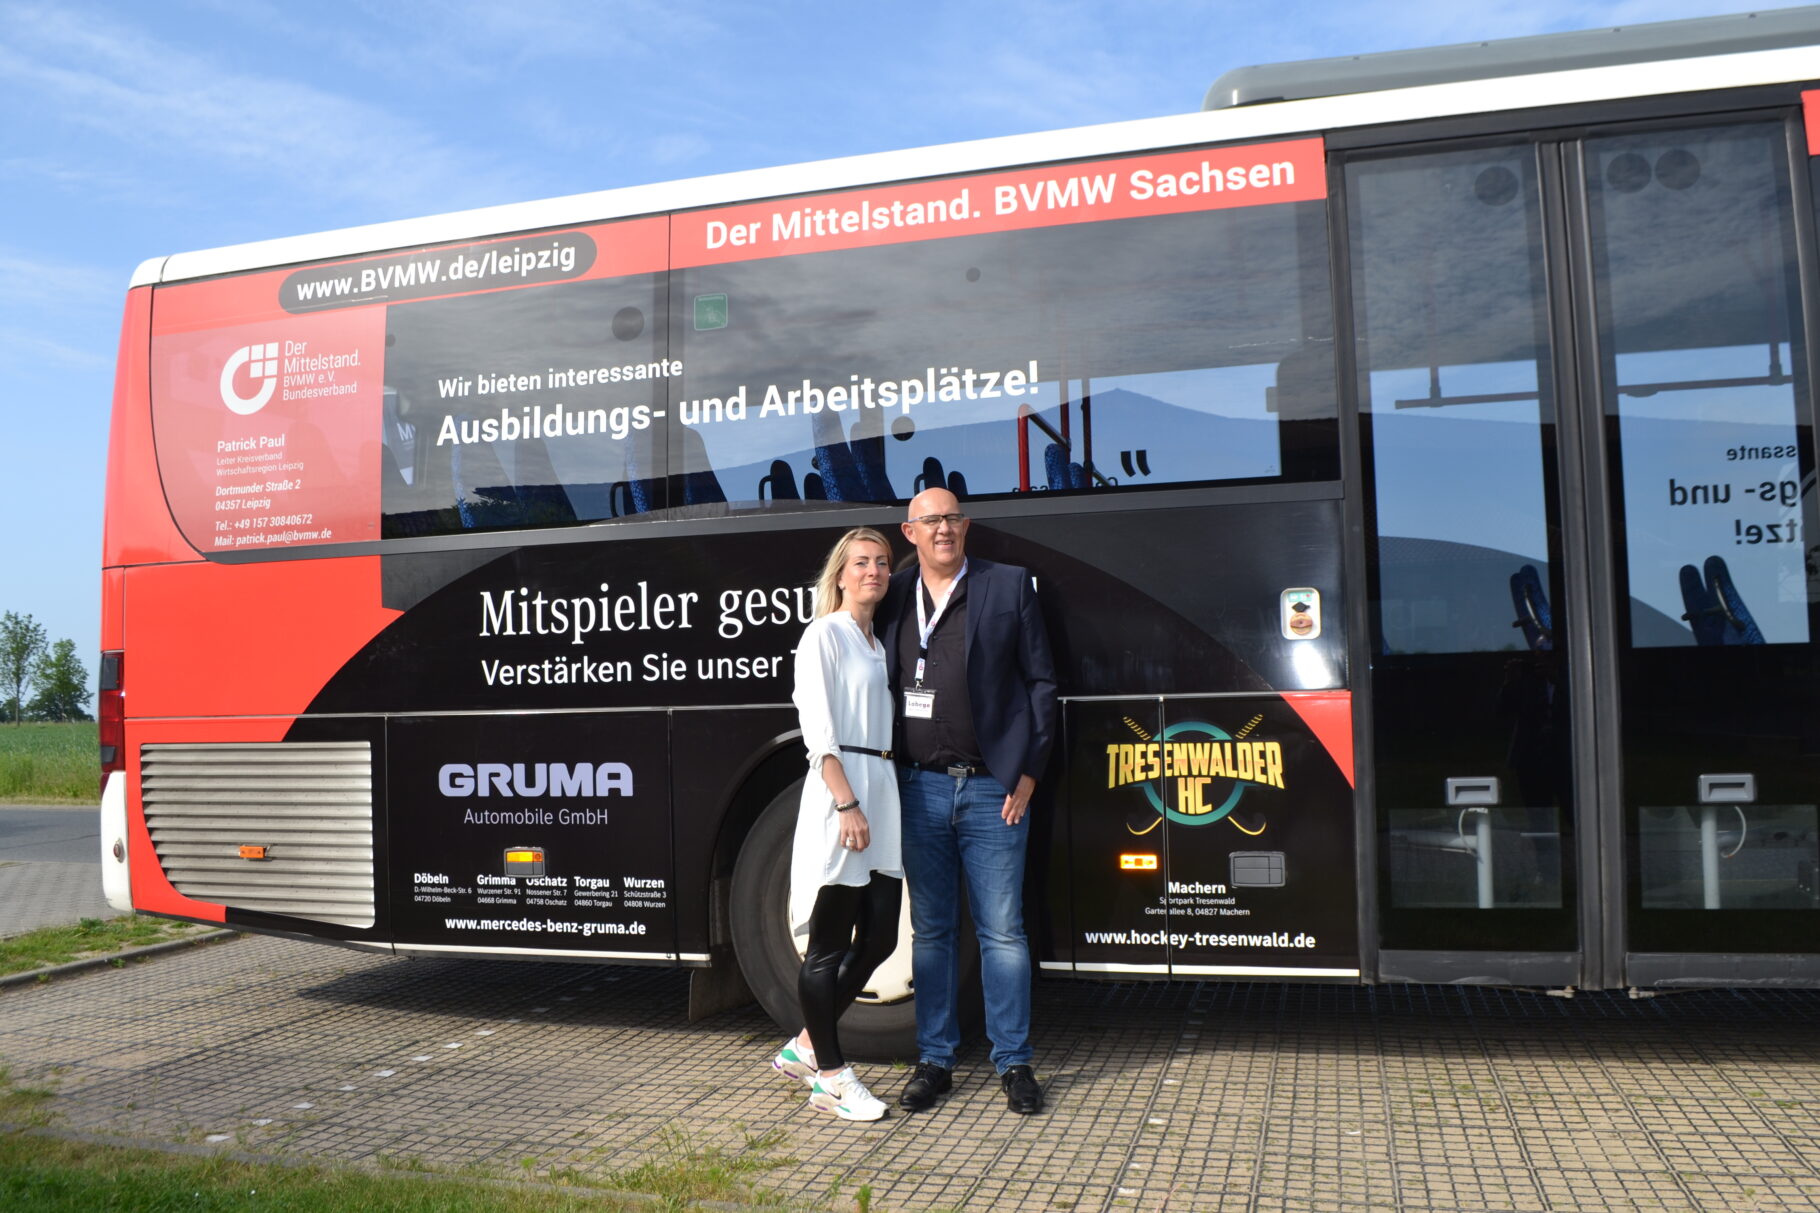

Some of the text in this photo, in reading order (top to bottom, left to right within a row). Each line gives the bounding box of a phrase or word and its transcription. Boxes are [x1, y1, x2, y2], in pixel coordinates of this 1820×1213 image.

[706, 160, 1296, 250] Der Mittelstand. BVMW Sachsen
[296, 242, 577, 301] www.BVMW.de/leipzig
[285, 340, 307, 356] Der
[284, 349, 361, 374] Mittelstand.
[283, 373, 315, 387] BVMW
[438, 358, 683, 398] Wir bieten interessante
[283, 381, 357, 400] Bundesverband
[436, 360, 1040, 447] Ausbildungs- und Arbeitsplätze!
[217, 434, 285, 453] Patrick Paul
[217, 452, 283, 466] Leiter Kreisverband
[216, 461, 304, 476] Wirtschaftsregion Leipzig
[216, 479, 301, 496] Dortmunder Straße 2
[215, 497, 271, 511] 04357 Leipzig
[215, 514, 313, 531] Tel.: +49 157 30840672
[215, 528, 332, 547] Mail: patrick.paul@bvmw.de
[479, 582, 818, 645] Mitspieler gesu
[481, 652, 782, 687] Verstärken Sie unser
[1106, 741, 1285, 789] TRESENWALDER
[438, 762, 634, 797] GRUMA
[1177, 777, 1213, 815] HC
[464, 808, 608, 825] Automobile GmbH
[414, 873, 449, 884] Döbeln
[477, 874, 516, 885] Grimma
[526, 876, 567, 886] Oschatz
[574, 876, 610, 889] Torgau
[624, 877, 665, 888] Wurzen
[477, 887, 503, 895] Wurzener
[526, 888, 552, 896] Nossener
[574, 890, 610, 898] Gewerbering
[1168, 881, 1226, 894] Machern
[594, 900, 612, 908] Torgau
[1196, 897, 1235, 905] Tresenwald
[1187, 908, 1194, 916] 8,
[1219, 908, 1250, 916] Machern
[445, 918, 646, 936] www.mercedes-benz-gruma.de
[1085, 929, 1316, 949] www.hockey-tresenwald.de
